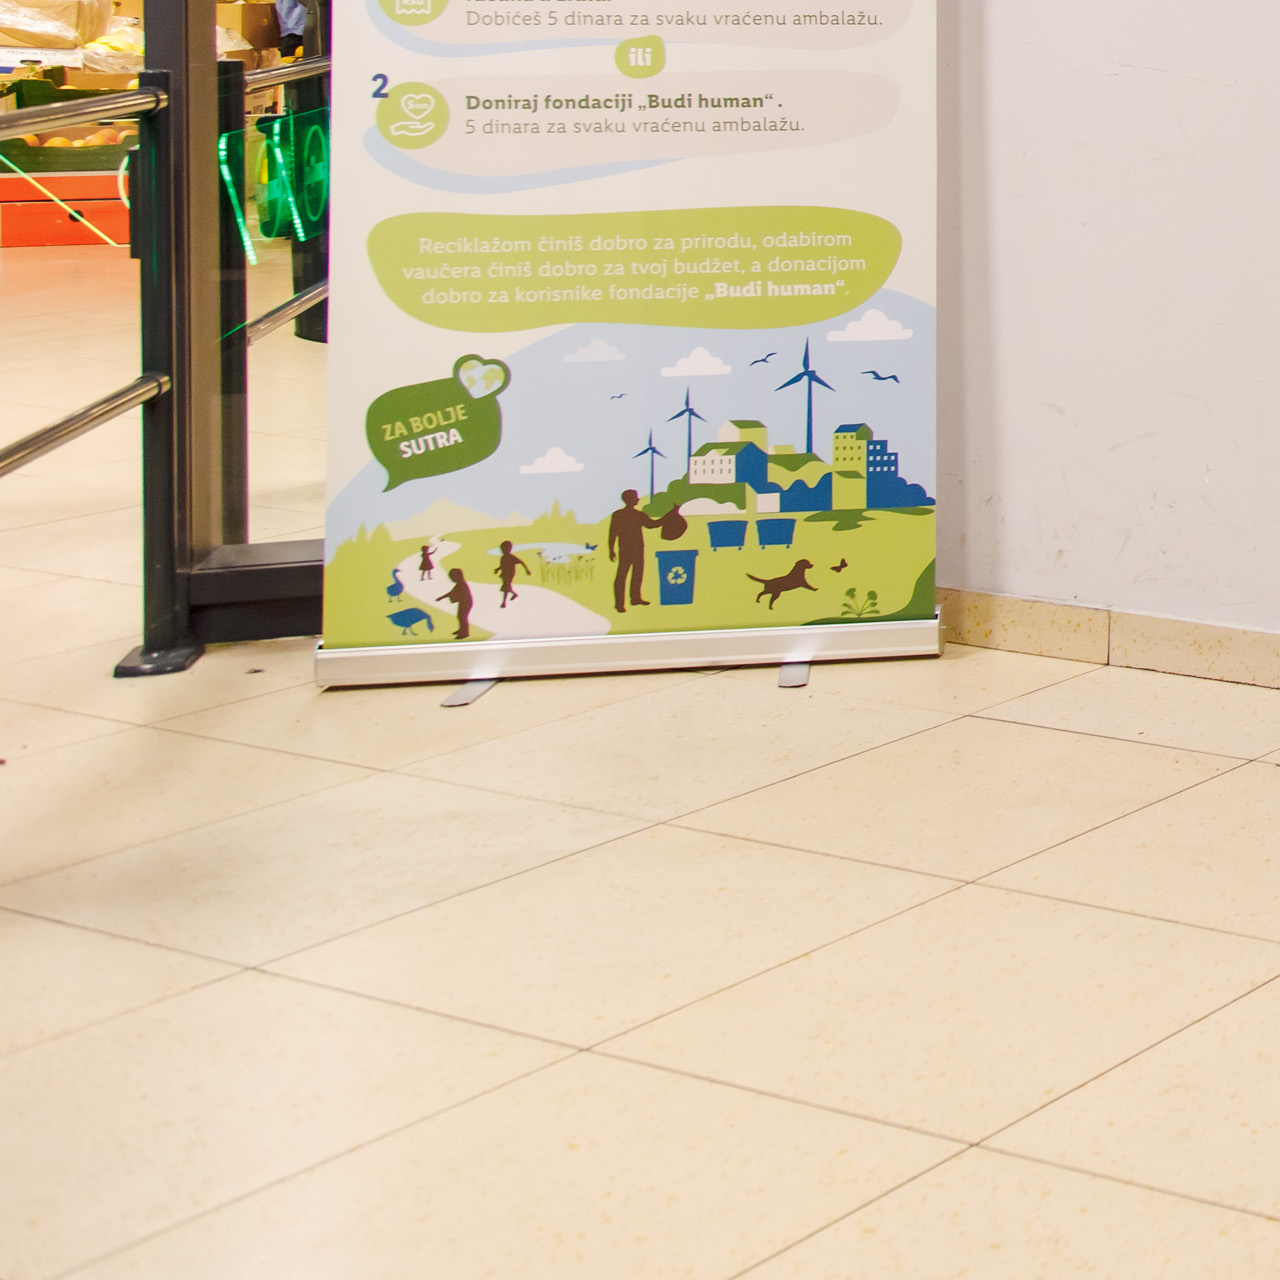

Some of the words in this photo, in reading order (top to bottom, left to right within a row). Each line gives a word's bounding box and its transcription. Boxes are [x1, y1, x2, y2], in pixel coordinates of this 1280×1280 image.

[628, 48, 652, 67] ili
[372, 73, 389, 98] 2
[422, 287, 482, 305] dobro
[487, 290, 509, 303] za
[515, 285, 602, 302] korisnike
[609, 283, 699, 303] fondacije
[705, 280, 762, 301] „Budi
[767, 279, 850, 297] human“.
[381, 421, 408, 441] ZA
[409, 404, 468, 433] BOLJE
[399, 428, 463, 458] SUTRA
